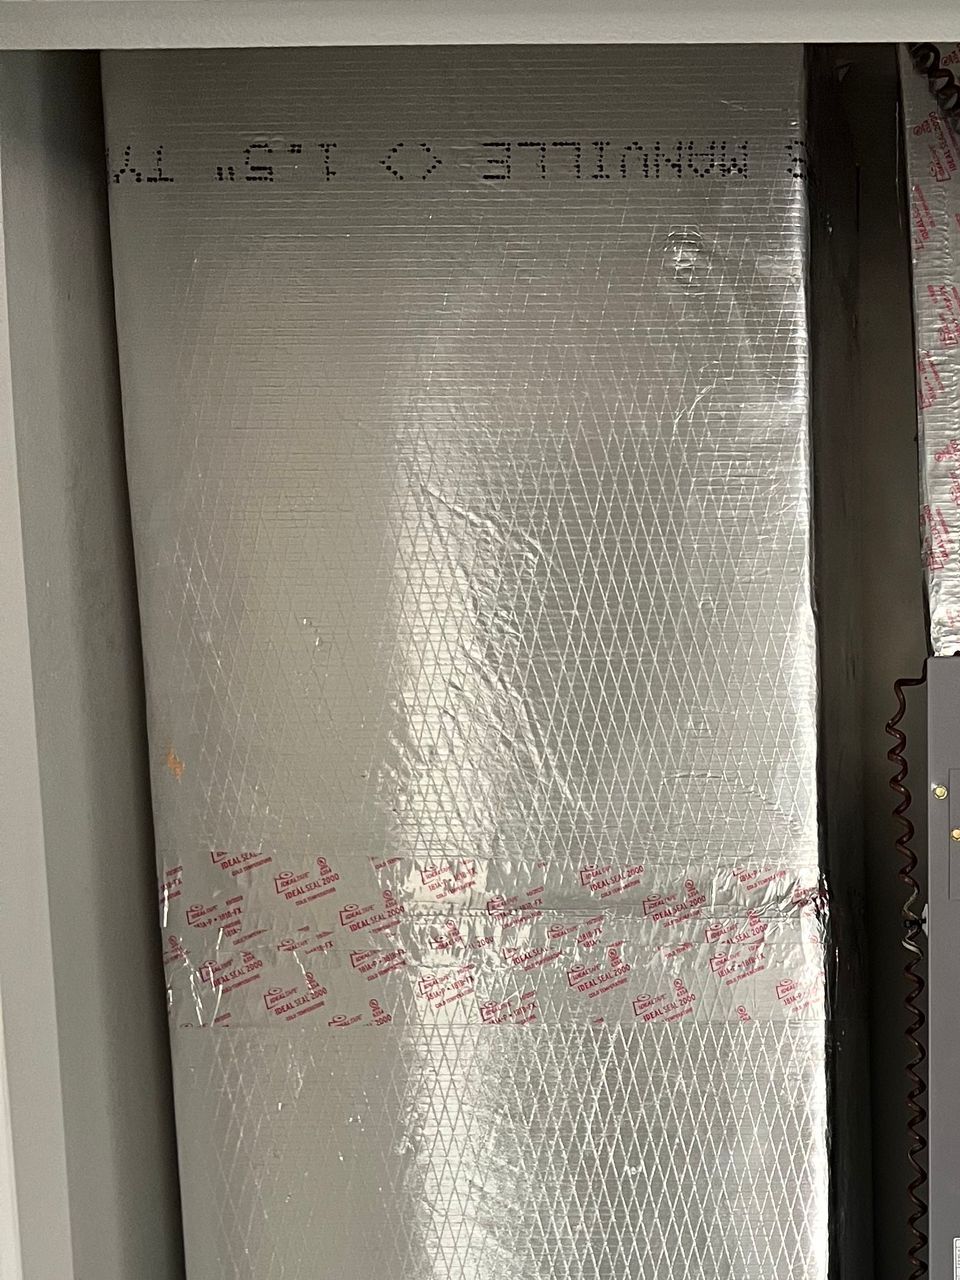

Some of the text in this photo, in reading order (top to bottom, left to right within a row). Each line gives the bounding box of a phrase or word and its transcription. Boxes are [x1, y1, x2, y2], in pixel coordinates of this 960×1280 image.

[482, 141, 749, 180] MANVILLE
[590, 879, 610, 891] IDEAL
[285, 887, 304, 900] IDEAL
[653, 909, 673, 921] IDEAL
[349, 920, 369, 932] IDEAL
[578, 964, 631, 992] IDEAL SEAL 2000
[275, 1003, 294, 1015] IDEAL
[643, 1009, 663, 1022] IDEAL
